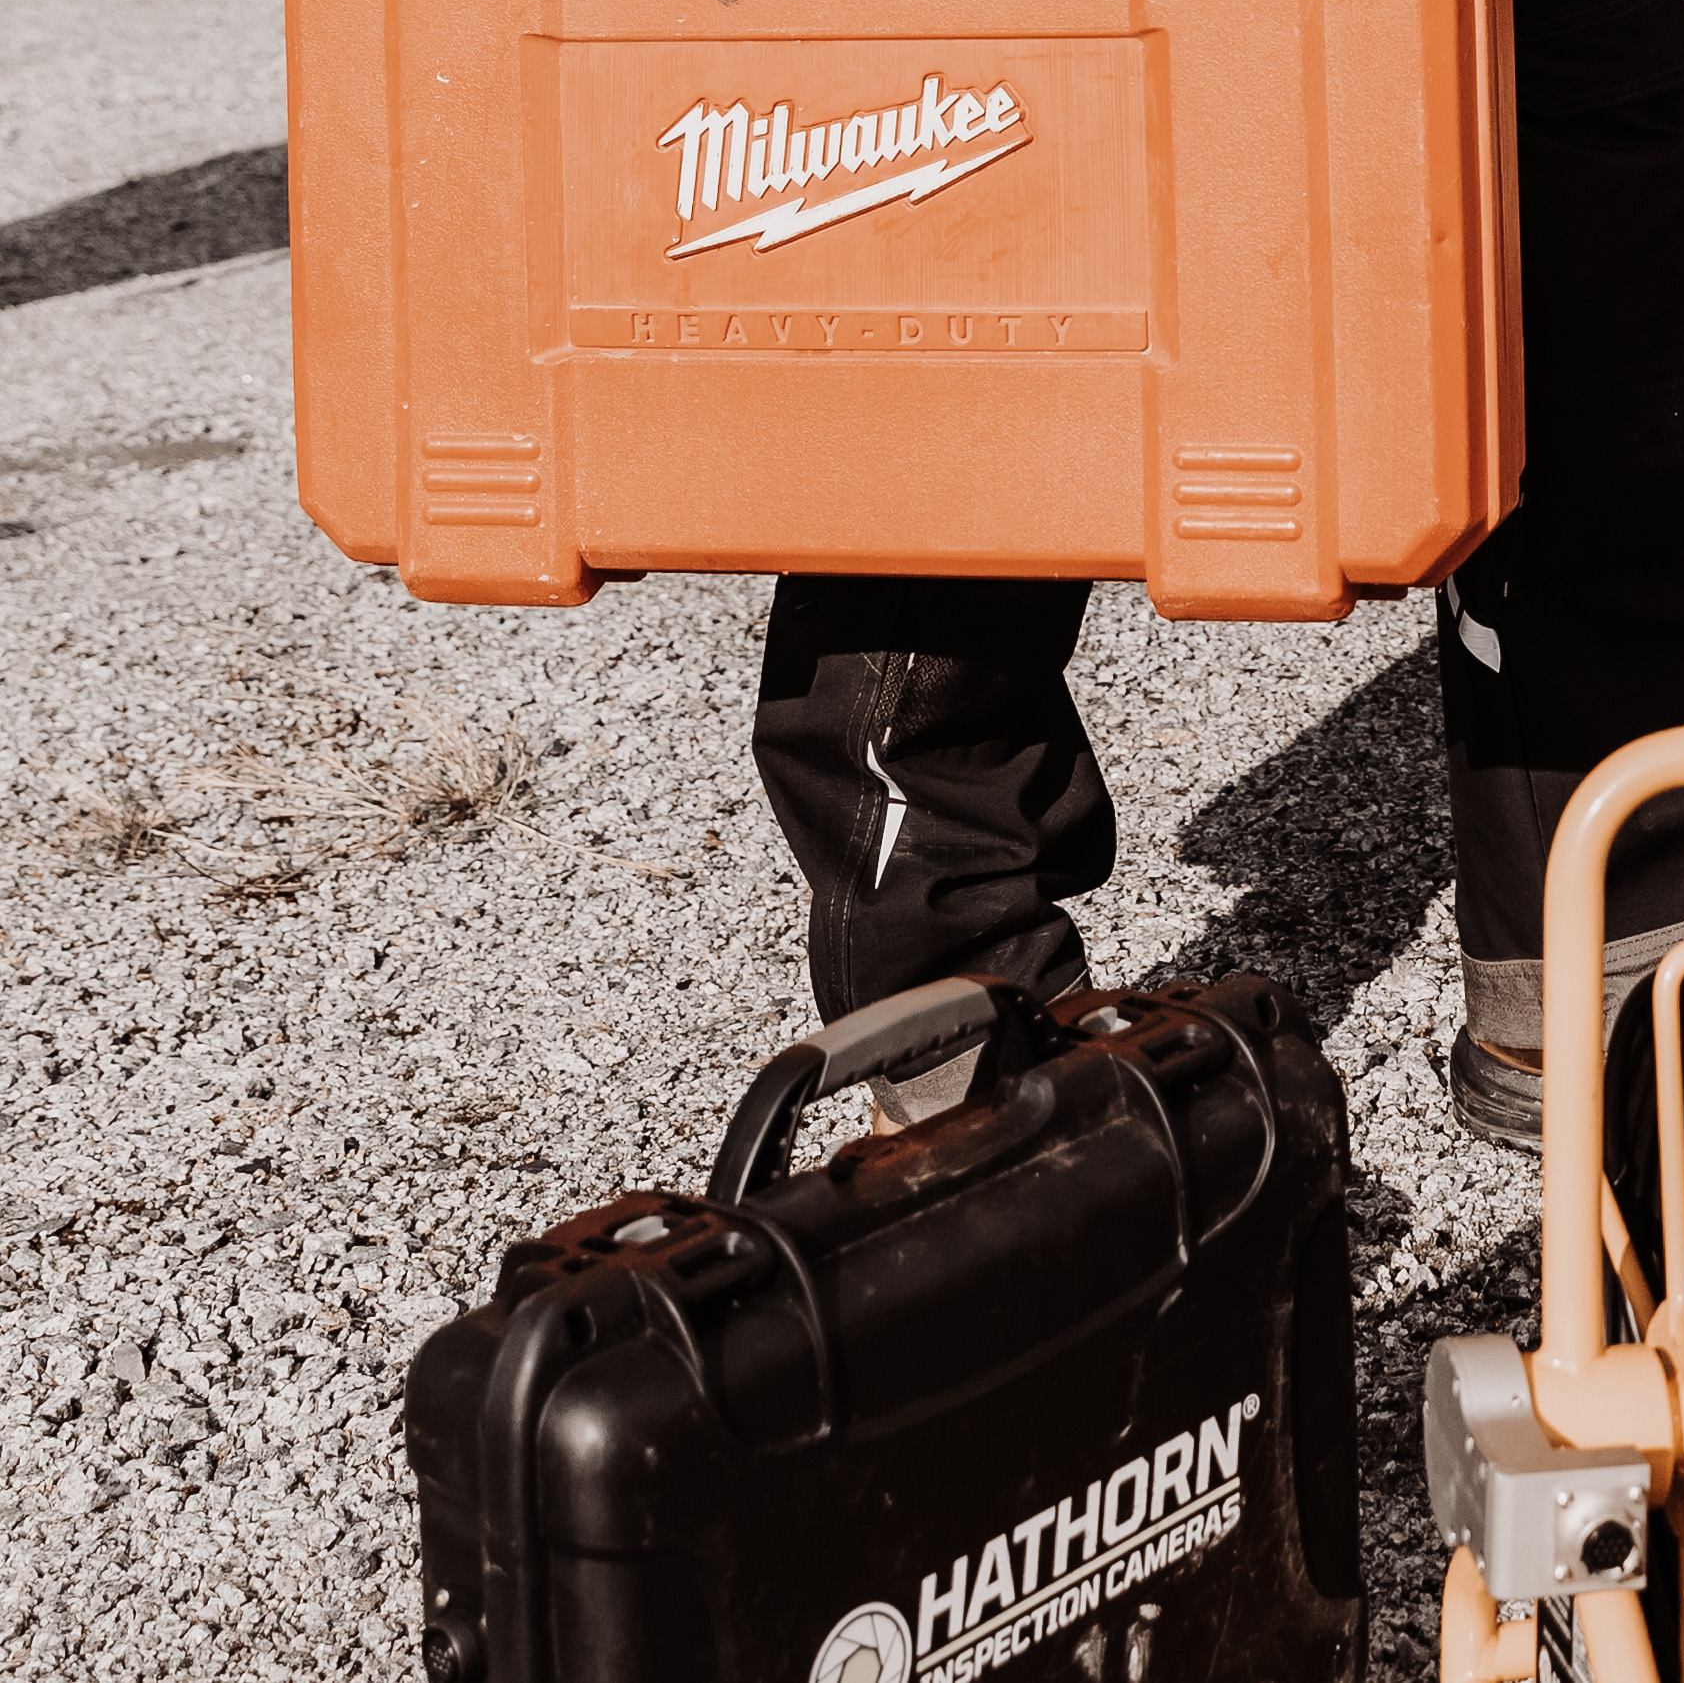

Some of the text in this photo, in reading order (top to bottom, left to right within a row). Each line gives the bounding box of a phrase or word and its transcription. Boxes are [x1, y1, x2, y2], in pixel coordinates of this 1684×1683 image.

[660, 77, 1021, 221] Milwaukee
[631, 314, 1074, 346] HEAVY-DUTY
[1105, 1492, 1241, 1600] CAMERAS
